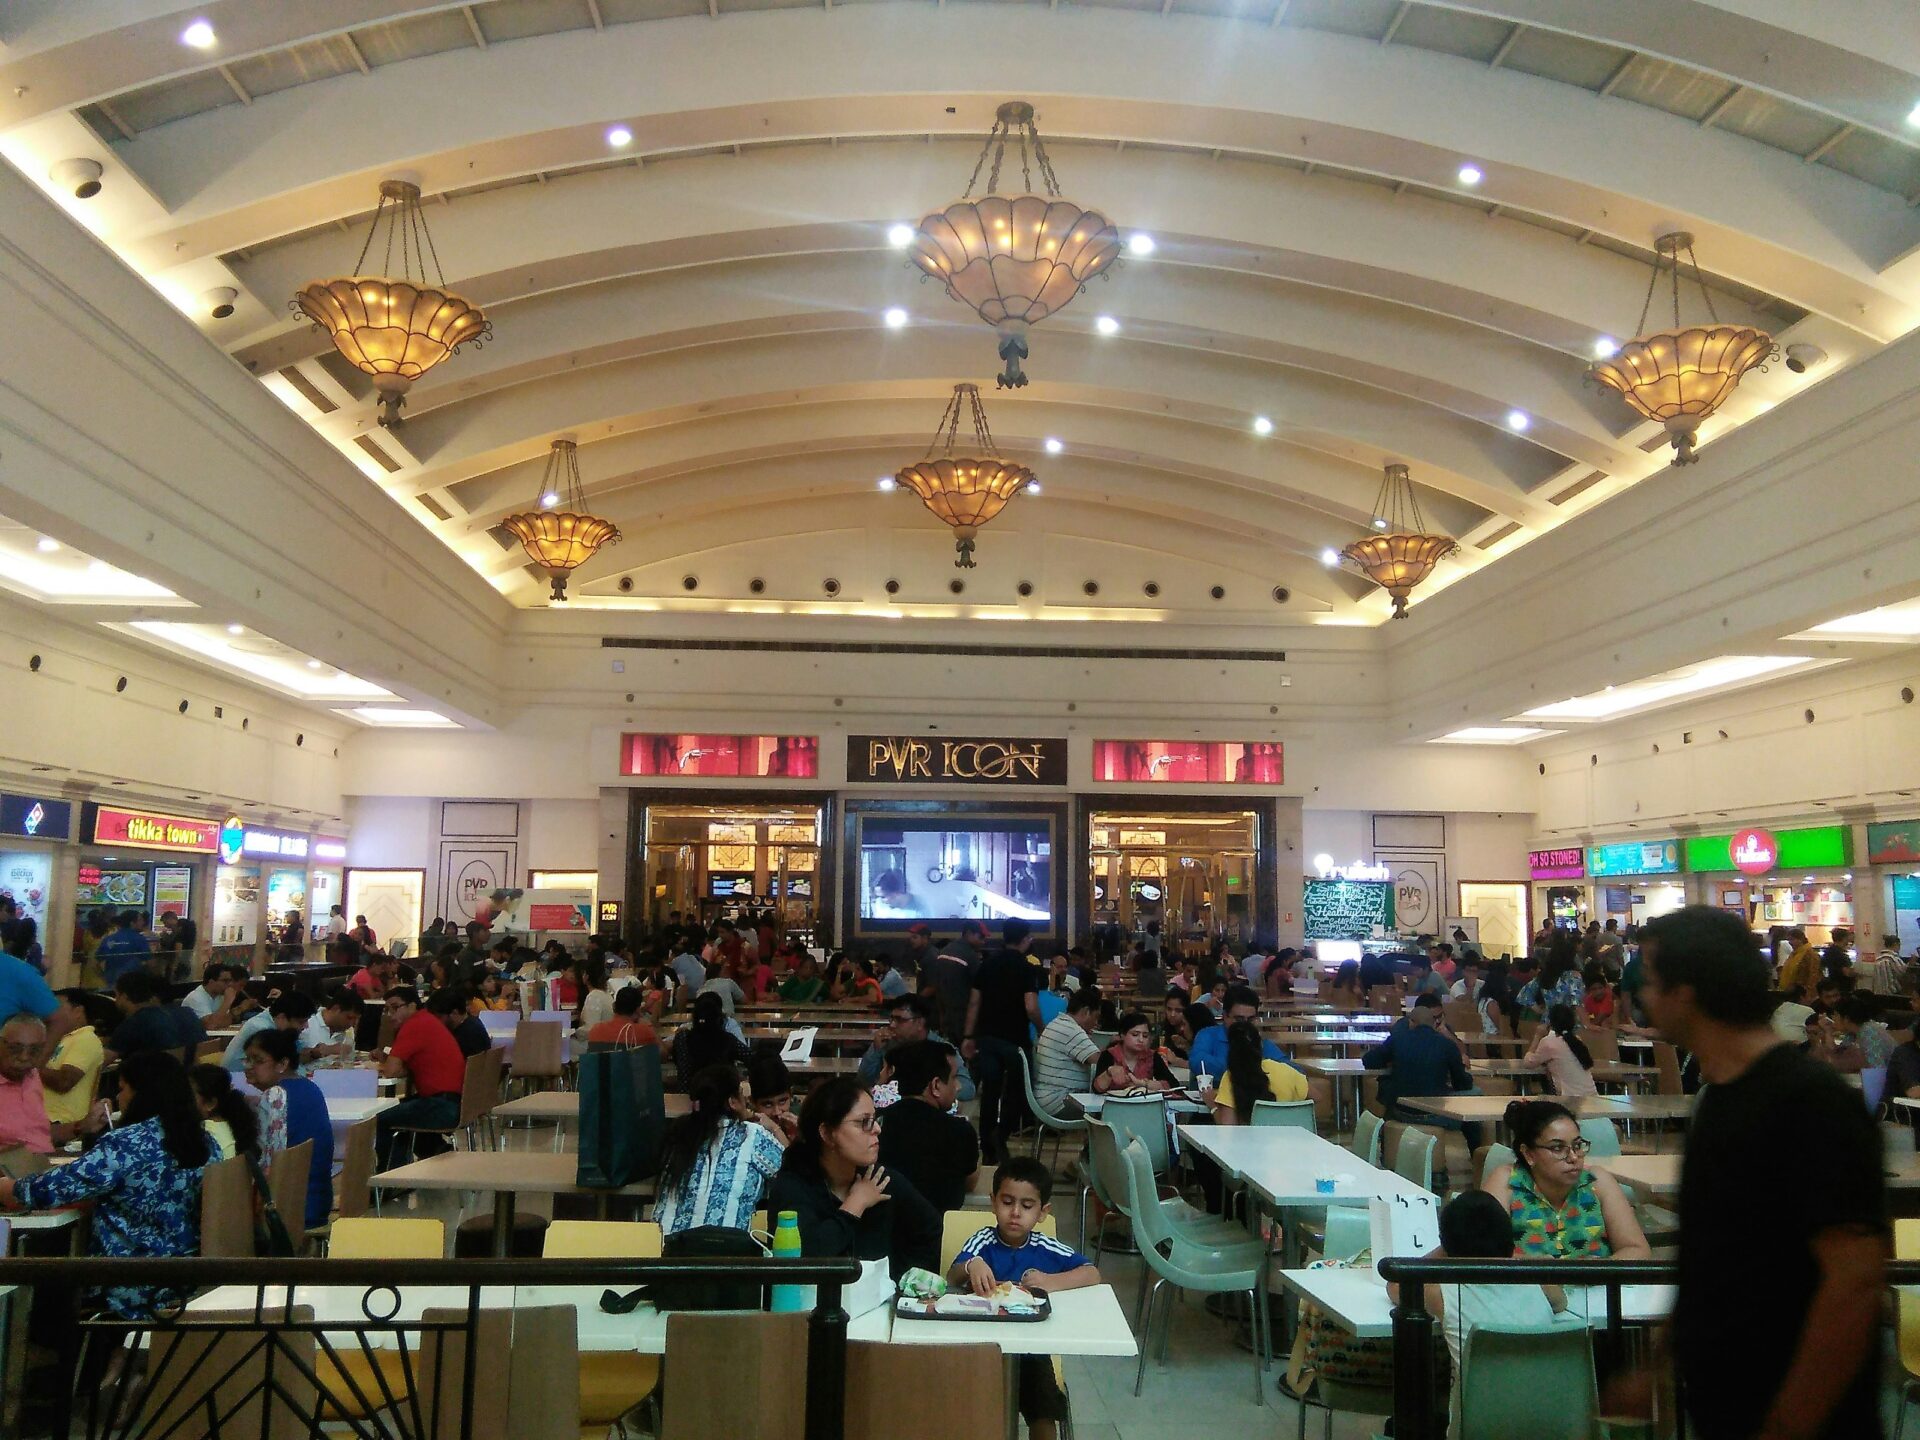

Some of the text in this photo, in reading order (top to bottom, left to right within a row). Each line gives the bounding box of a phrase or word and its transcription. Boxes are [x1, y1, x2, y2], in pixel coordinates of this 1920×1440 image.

[869, 737, 1045, 780] PVR ICON
[128, 818, 163, 841] tikka
[166, 824, 197, 844] town
[1540, 852, 1549, 867] SO
[1550, 850, 1580, 866] STONED!
[1399, 886, 1421, 901] PVR
[601, 903, 618, 914] PVR
